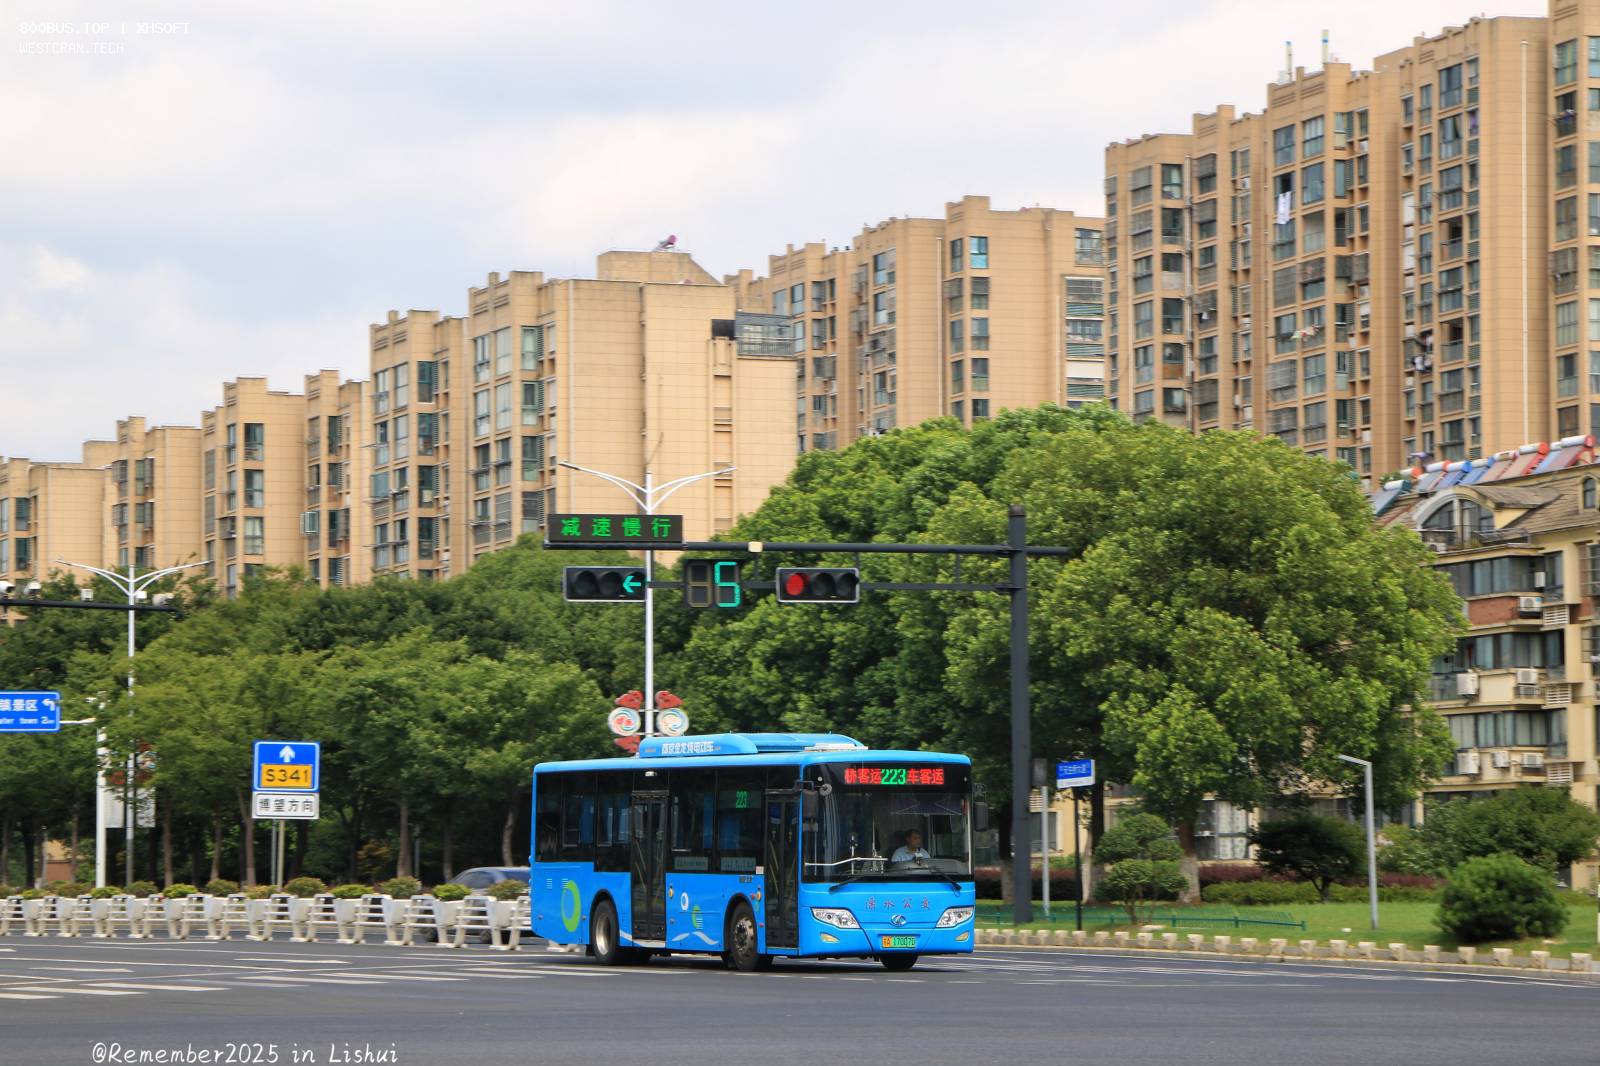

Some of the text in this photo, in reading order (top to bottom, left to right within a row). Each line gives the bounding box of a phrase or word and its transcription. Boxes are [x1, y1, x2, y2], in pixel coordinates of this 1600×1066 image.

[561, 517, 672, 537] 减速慢行
[714, 561, 741, 608] 5
[265, 768, 309, 783] S341
[259, 798, 313, 813] 博望方向
